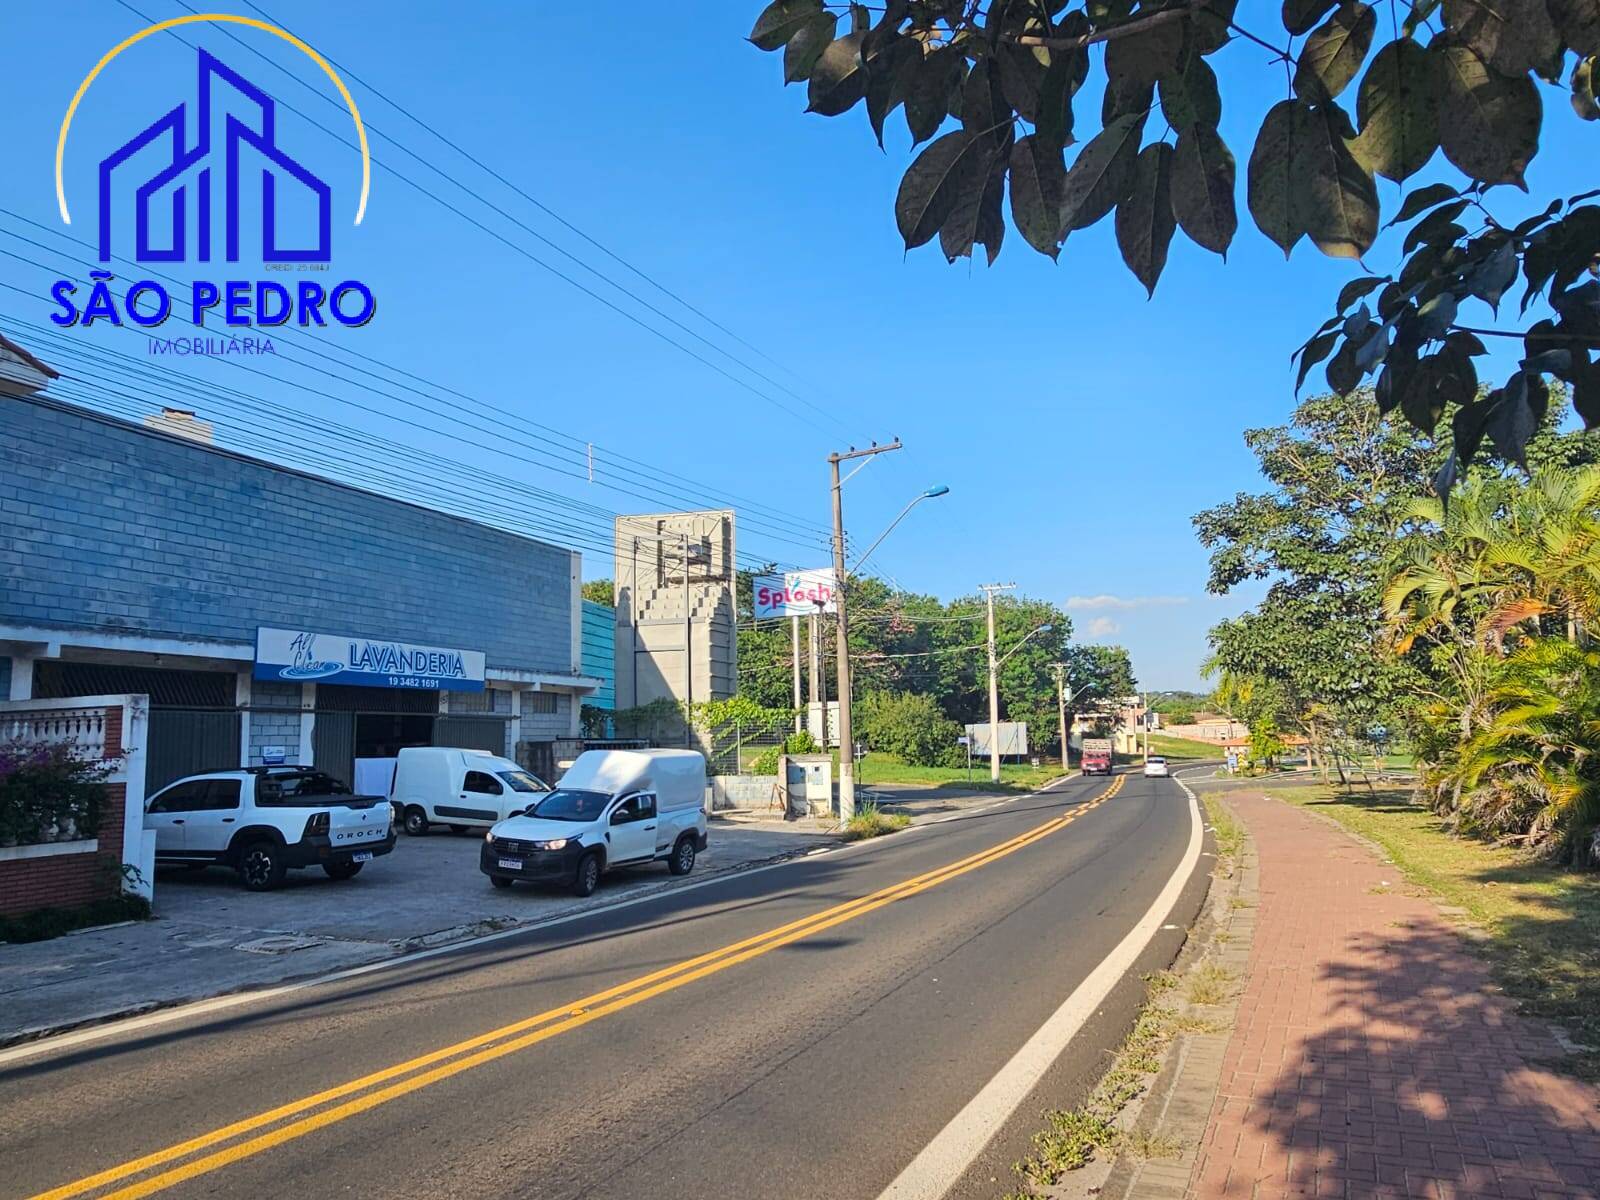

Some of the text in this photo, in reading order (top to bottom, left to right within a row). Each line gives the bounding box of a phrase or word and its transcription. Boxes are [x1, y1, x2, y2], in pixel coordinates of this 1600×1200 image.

[758, 583, 831, 609] Splash
[349, 641, 467, 678] LAVANDERIA
[389, 676, 399, 686] 19
[421, 679, 439, 688] 1691
[336, 828, 383, 840] OROCH
